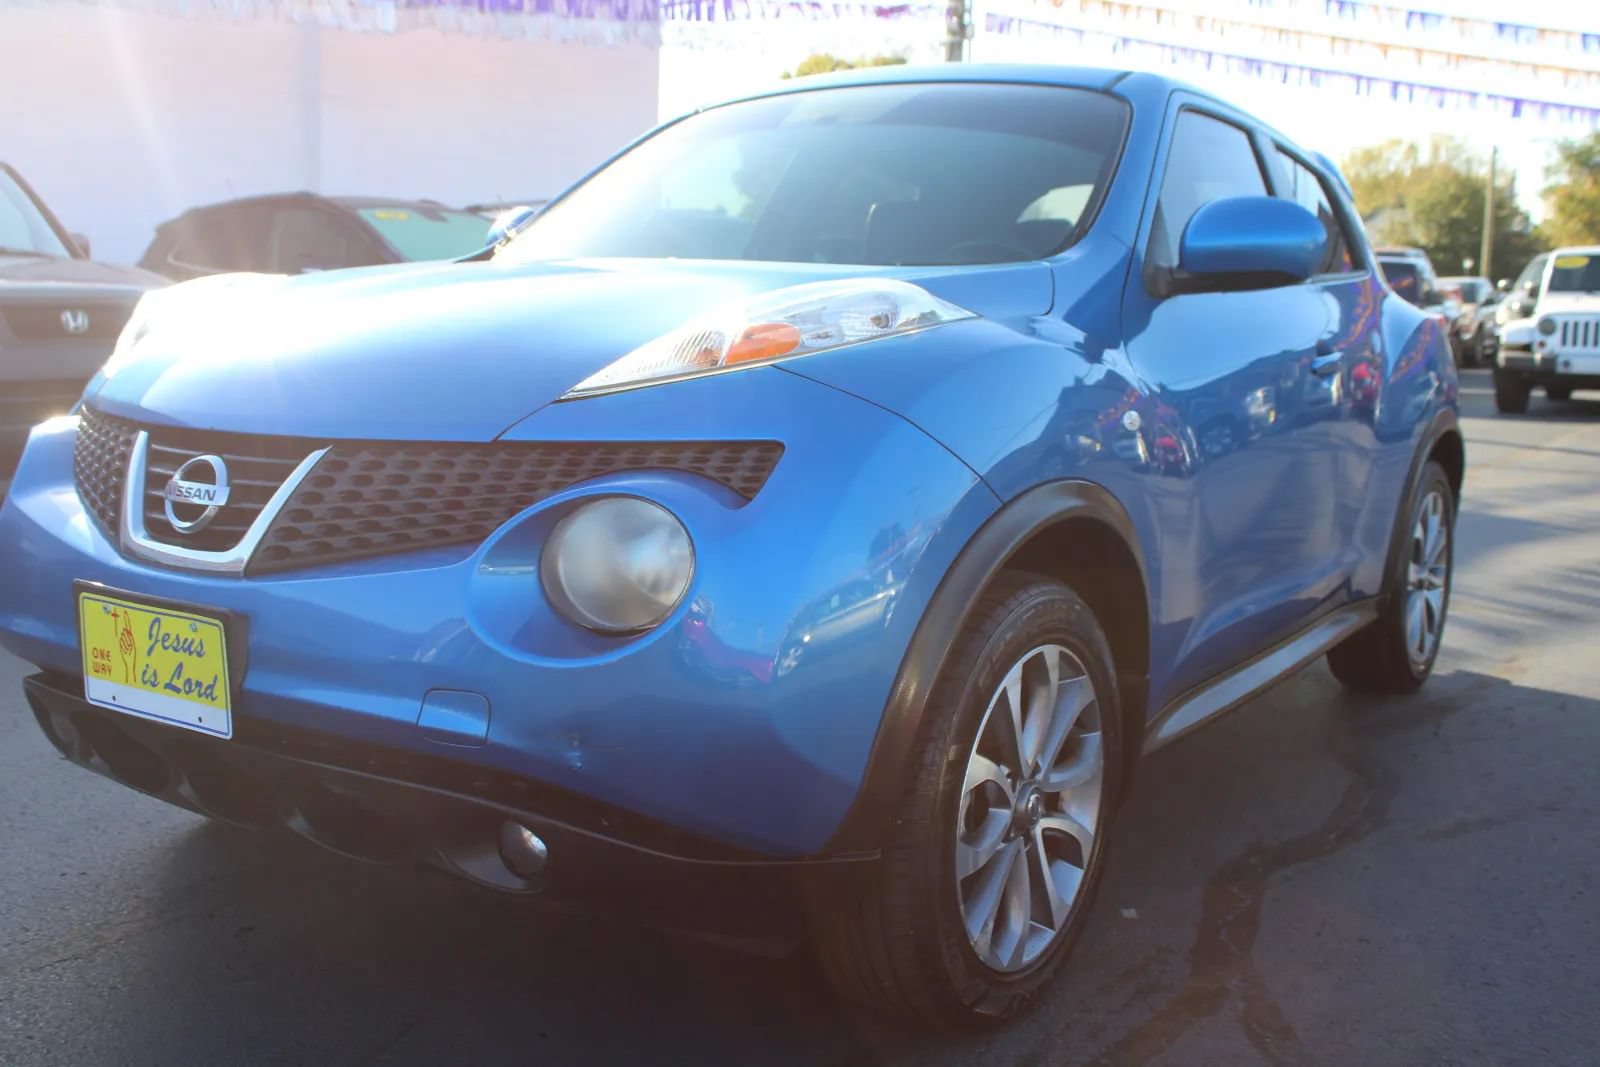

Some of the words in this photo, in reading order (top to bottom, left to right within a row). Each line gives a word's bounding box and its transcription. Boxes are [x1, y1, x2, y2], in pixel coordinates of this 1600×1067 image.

[147, 617, 205, 657] Jesus
[92, 648, 112, 661] ONE
[92, 662, 112, 676] WAY
[141, 663, 160, 687] is
[163, 661, 217, 701] Lord
